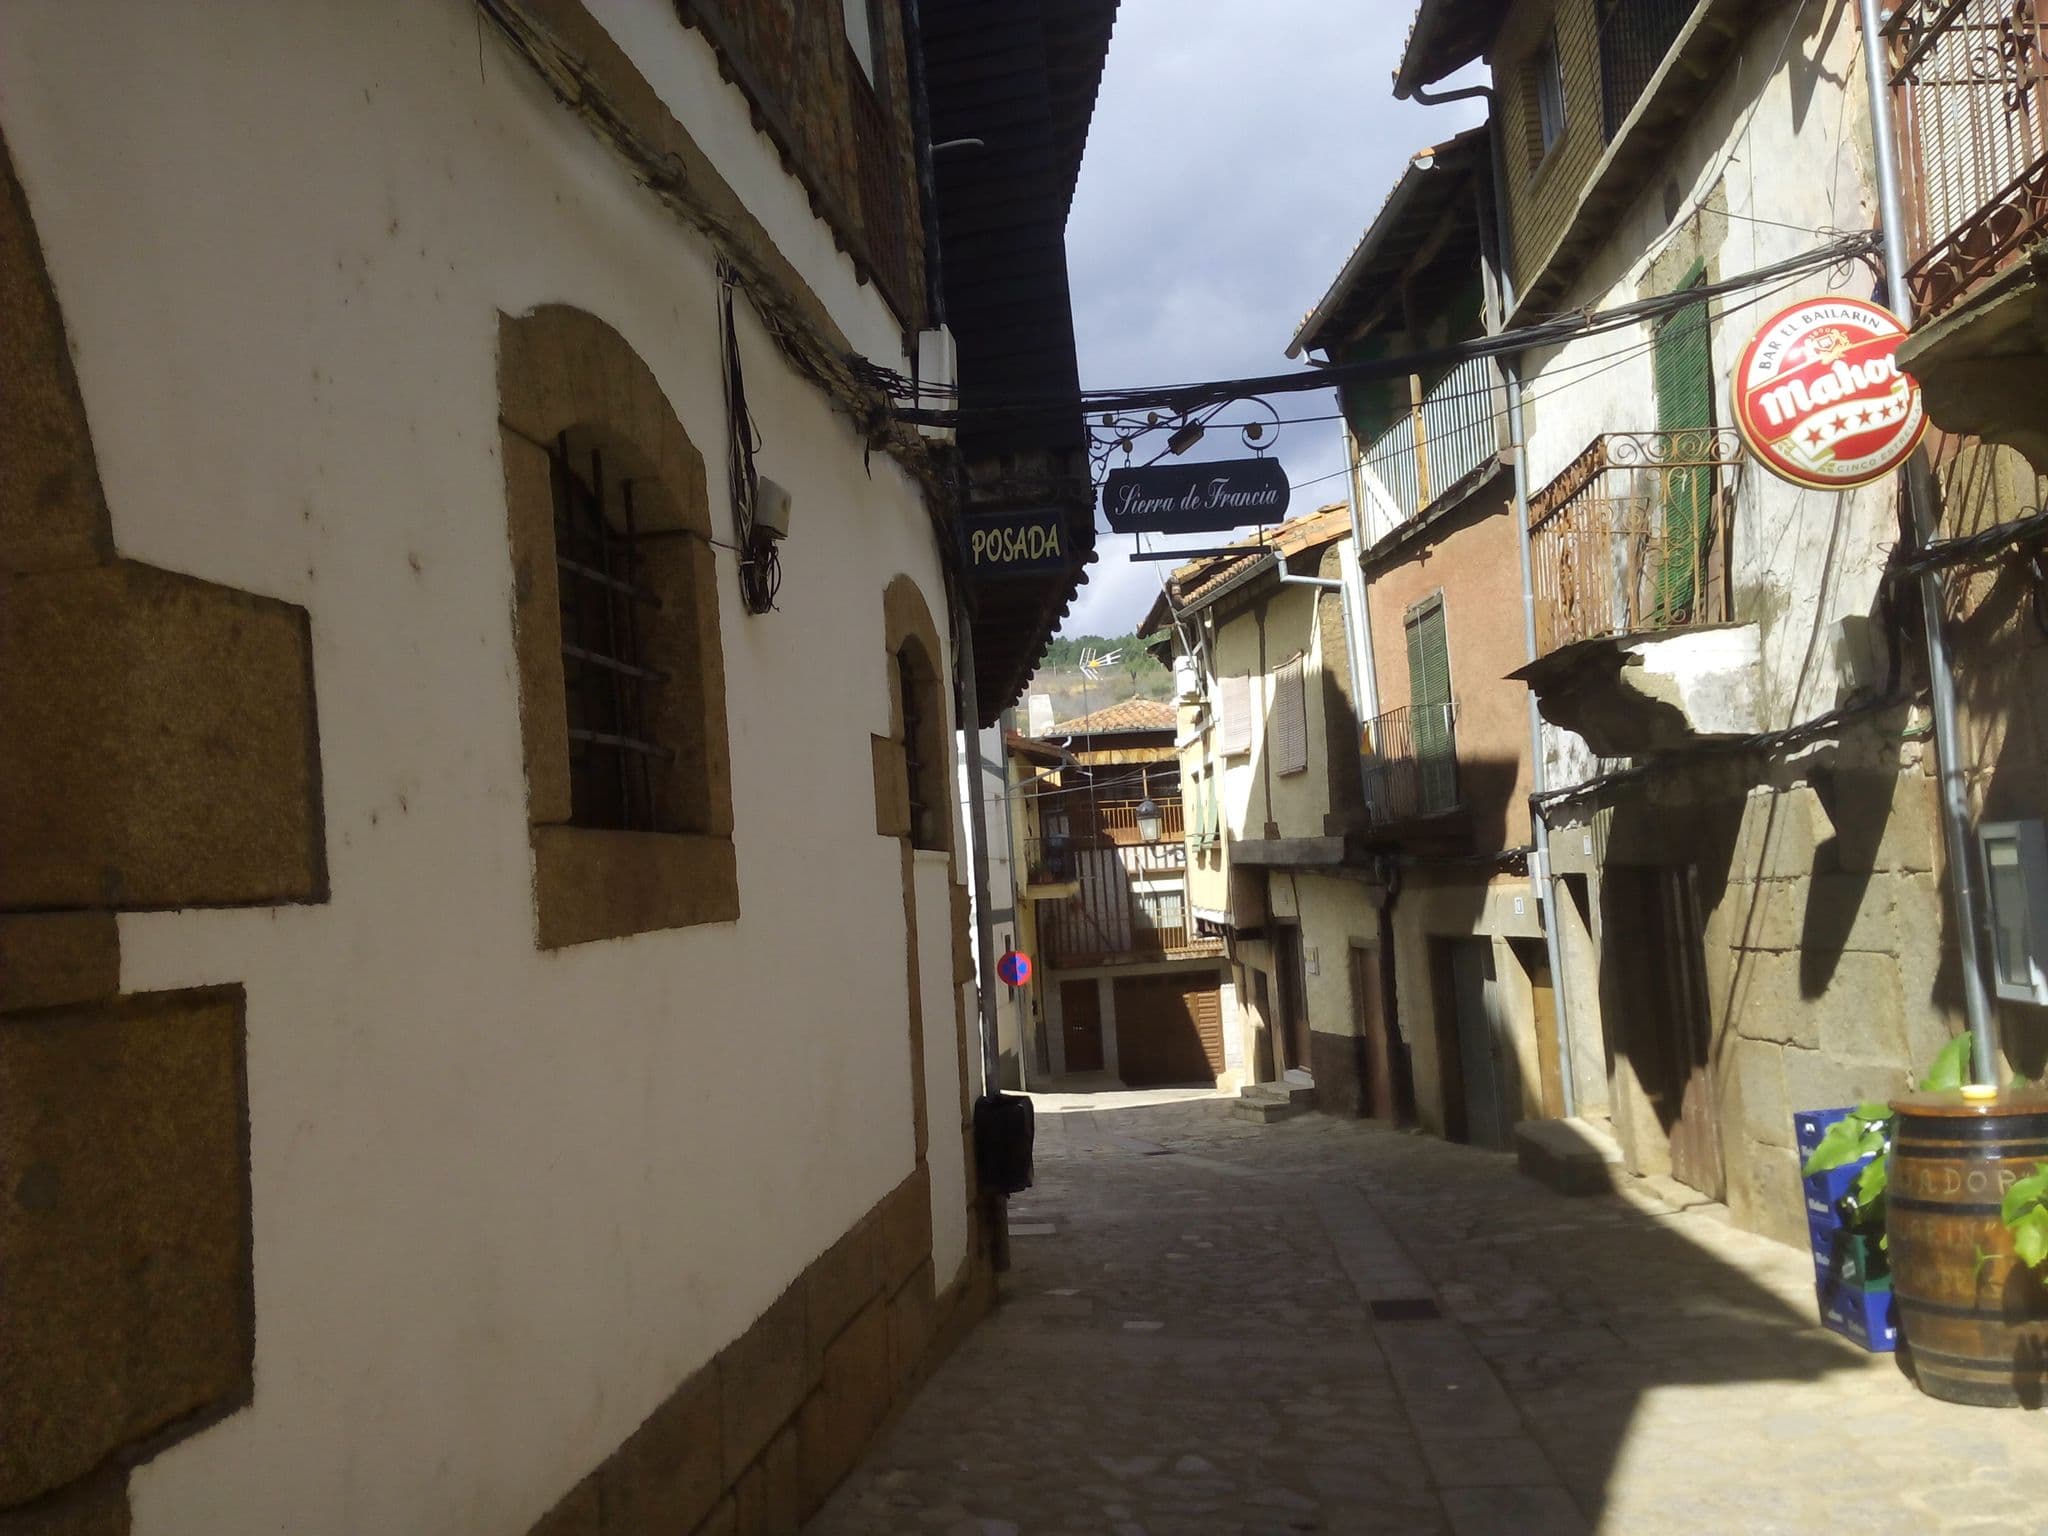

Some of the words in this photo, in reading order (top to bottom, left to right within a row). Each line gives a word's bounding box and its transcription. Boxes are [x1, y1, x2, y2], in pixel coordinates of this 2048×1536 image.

[1758, 340, 1782, 370] BAR
[1780, 323, 1798, 337] EL
[1801, 308, 1880, 329] BAILARIN
[1836, 458, 1877, 474] CINCO
[1115, 484, 1174, 515] Sierra
[1180, 483, 1200, 511] de
[1203, 477, 1280, 510] Francia
[971, 522, 1061, 566] POSADA
